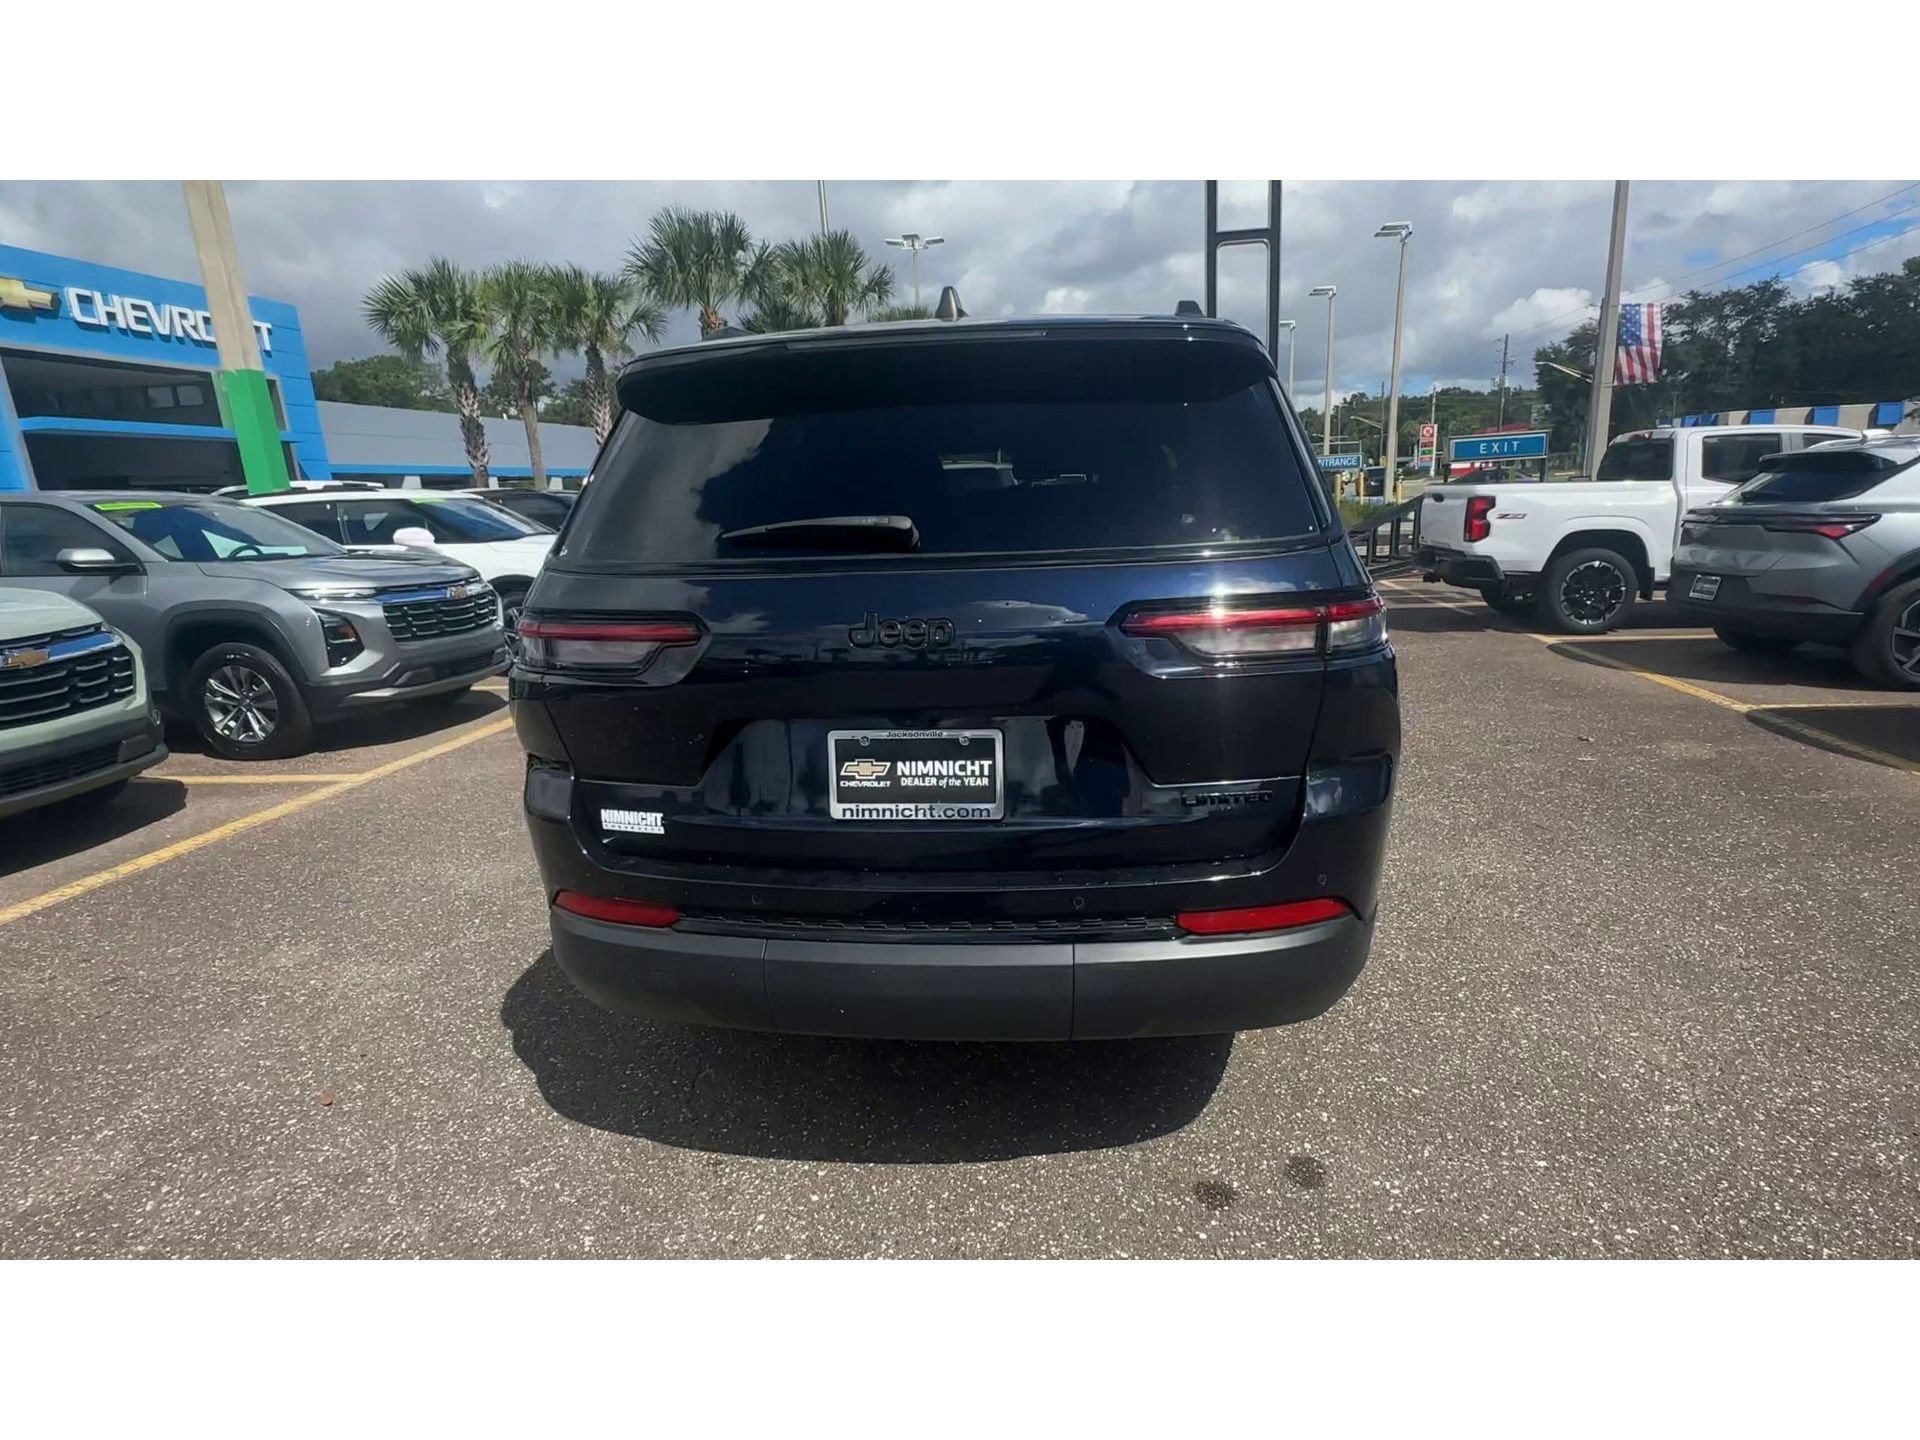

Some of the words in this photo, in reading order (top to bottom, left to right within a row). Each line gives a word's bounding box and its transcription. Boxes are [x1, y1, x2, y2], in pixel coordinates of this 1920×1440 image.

[65, 287, 272, 351] CHEVROT
[1480, 441, 1519, 454] EXIT
[1319, 458, 1358, 467] NTRANCE
[848, 611, 956, 656] Jeep
[885, 730, 943, 738] Jacksonville
[897, 760, 993, 776] NIMNICHT
[840, 780, 891, 788] CHEVROLET
[901, 777, 937, 787] DEALER
[938, 778, 947, 789] of
[949, 777, 961, 786] the
[963, 777, 989, 787] YEAR
[601, 808, 664, 827] NIMNICHT
[842, 804, 991, 818] nimnicht.com
